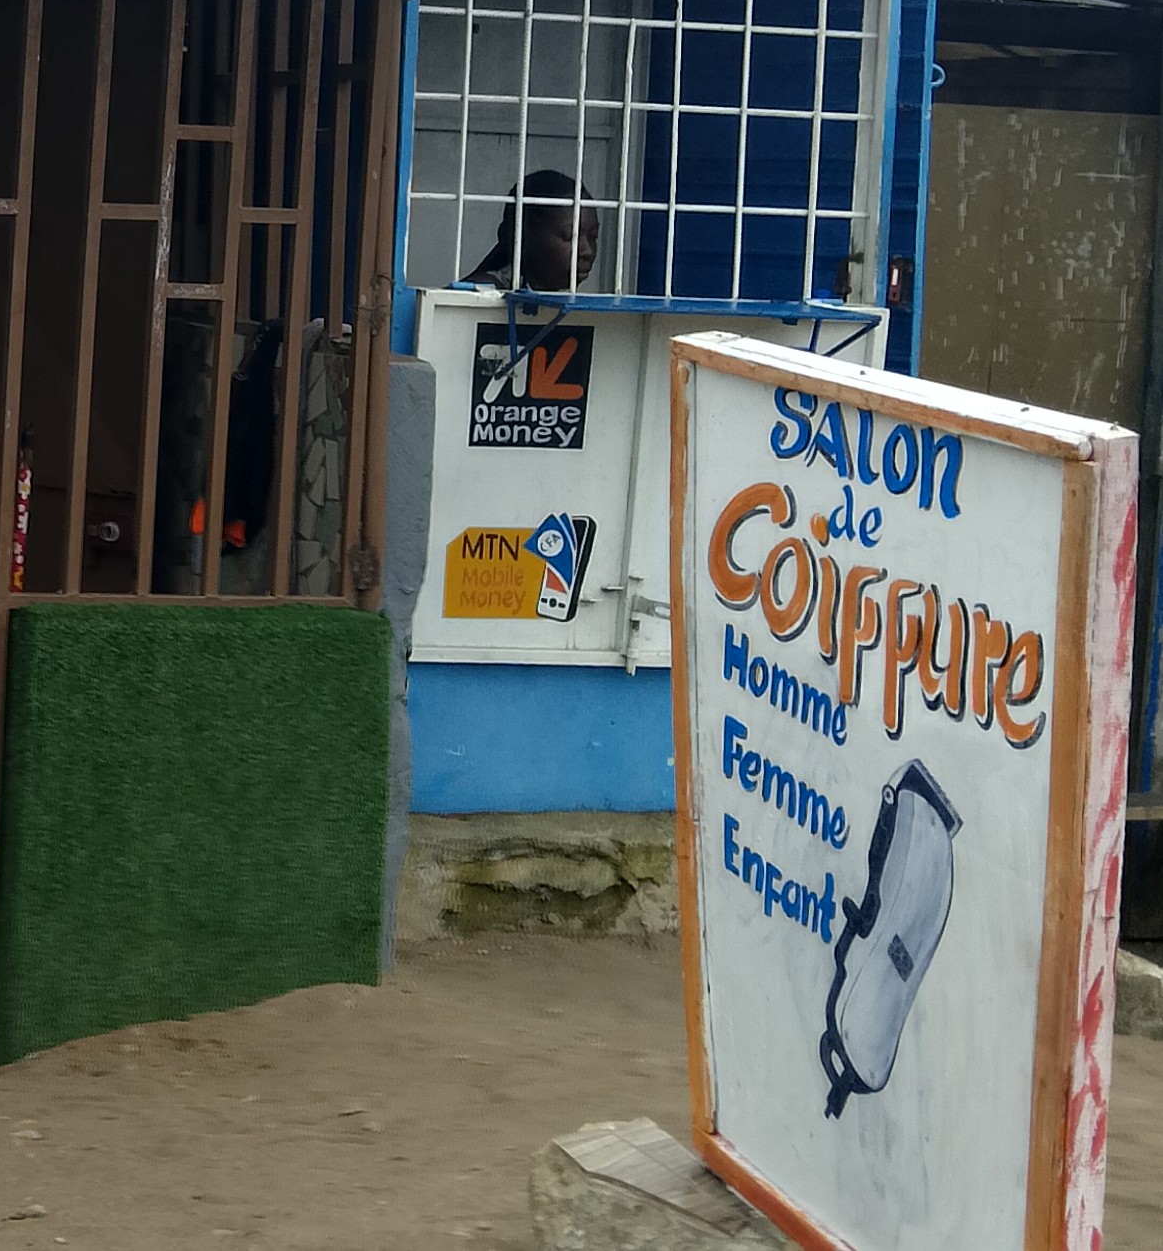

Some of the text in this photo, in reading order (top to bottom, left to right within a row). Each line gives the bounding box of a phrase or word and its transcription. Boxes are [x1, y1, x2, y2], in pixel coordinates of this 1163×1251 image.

[475, 403, 581, 426] Orange
[473, 422, 577, 447] Money
[830, 485, 883, 548] de
[462, 533, 519, 561] MTN
[540, 533, 561, 552] CFA
[462, 565, 524, 588] Mobile
[459, 589, 526, 616] Money
[723, 623, 847, 745] Homme
[723, 714, 851, 849] Femme
[723, 812, 837, 943] Enfant
